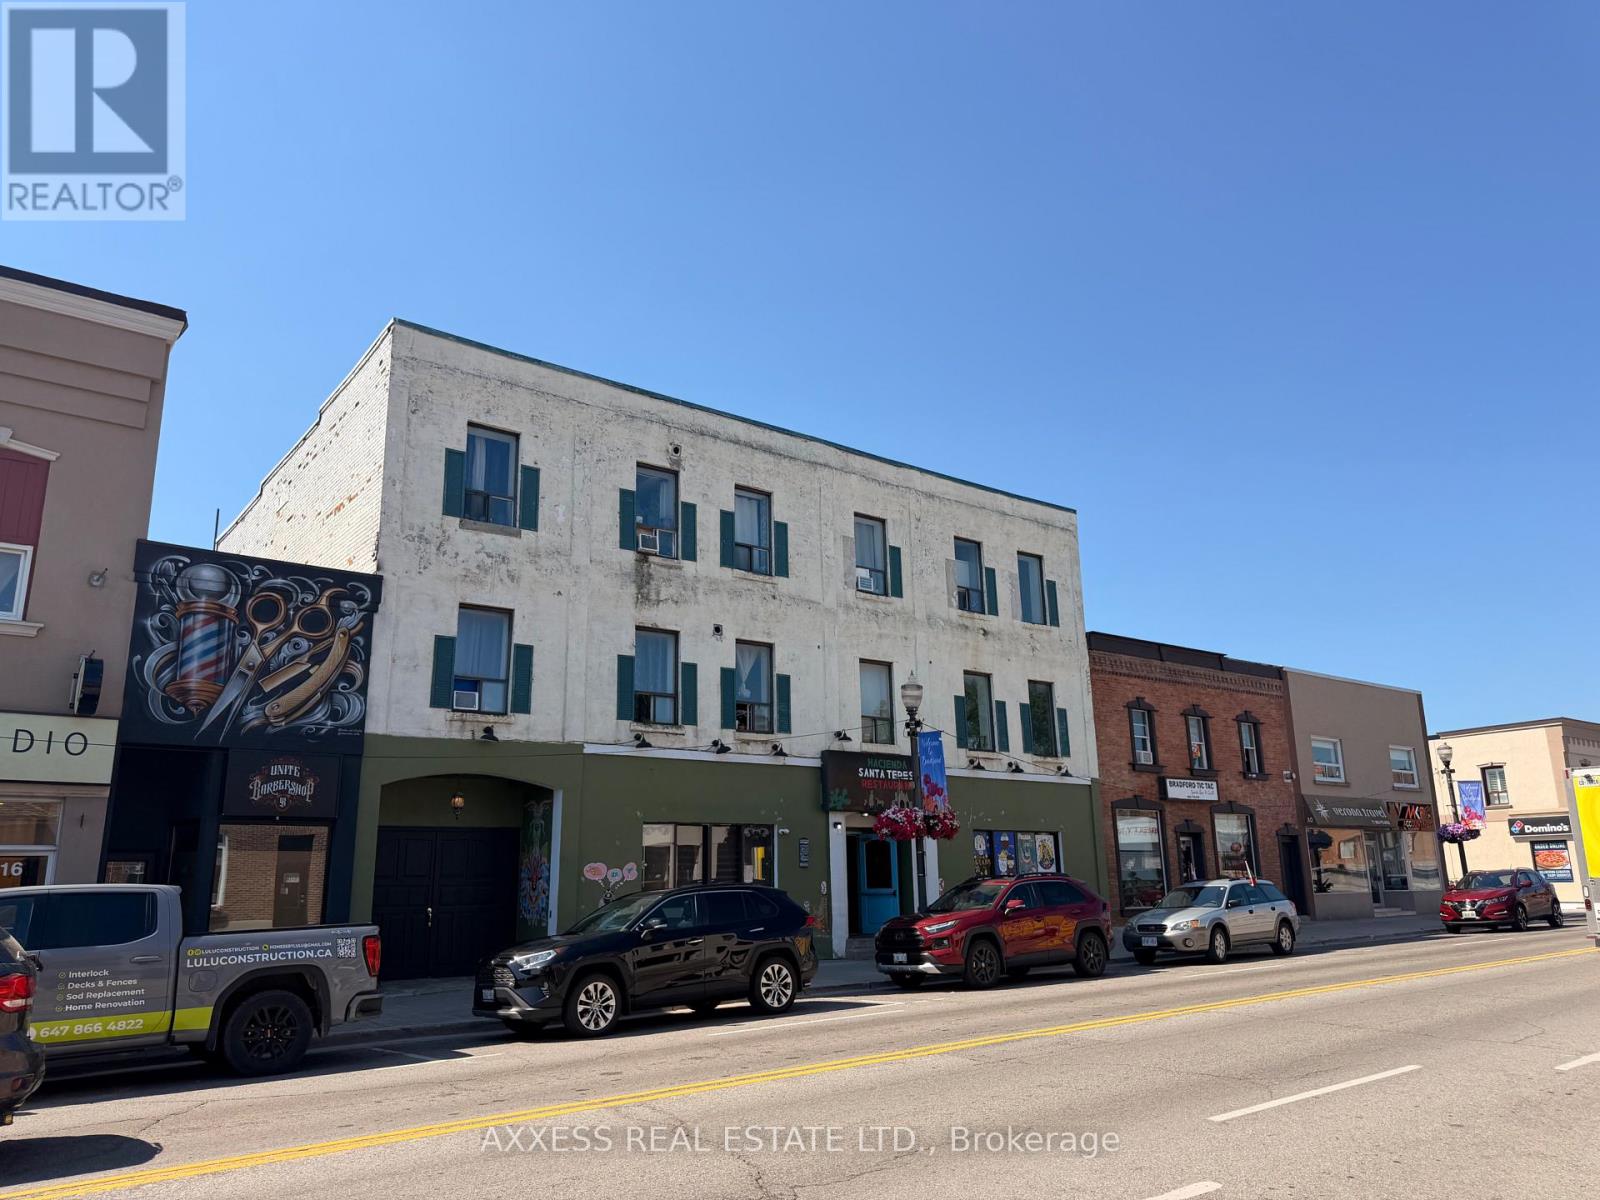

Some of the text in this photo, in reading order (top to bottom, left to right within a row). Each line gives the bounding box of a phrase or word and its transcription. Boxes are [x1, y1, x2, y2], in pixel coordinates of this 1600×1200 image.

[867, 758, 908, 769] HACIENDA
[858, 767, 914, 781] SANTA TERES
[1168, 780, 1197, 789] BRADFORD
[1205, 782, 1215, 790] TAC
[1332, 805, 1387, 818] verona travel
[1524, 822, 1570, 833] Domino's
[186, 949, 333, 968] LULUCONSTRUCTION.CA
[68, 969, 110, 979] Interlock
[67, 979, 138, 990] Decks & Fences
[66, 988, 145, 1001] Sod Replacement
[65, 999, 145, 1012] Home Renovation
[40, 1019, 144, 1038] 647 866 4822
